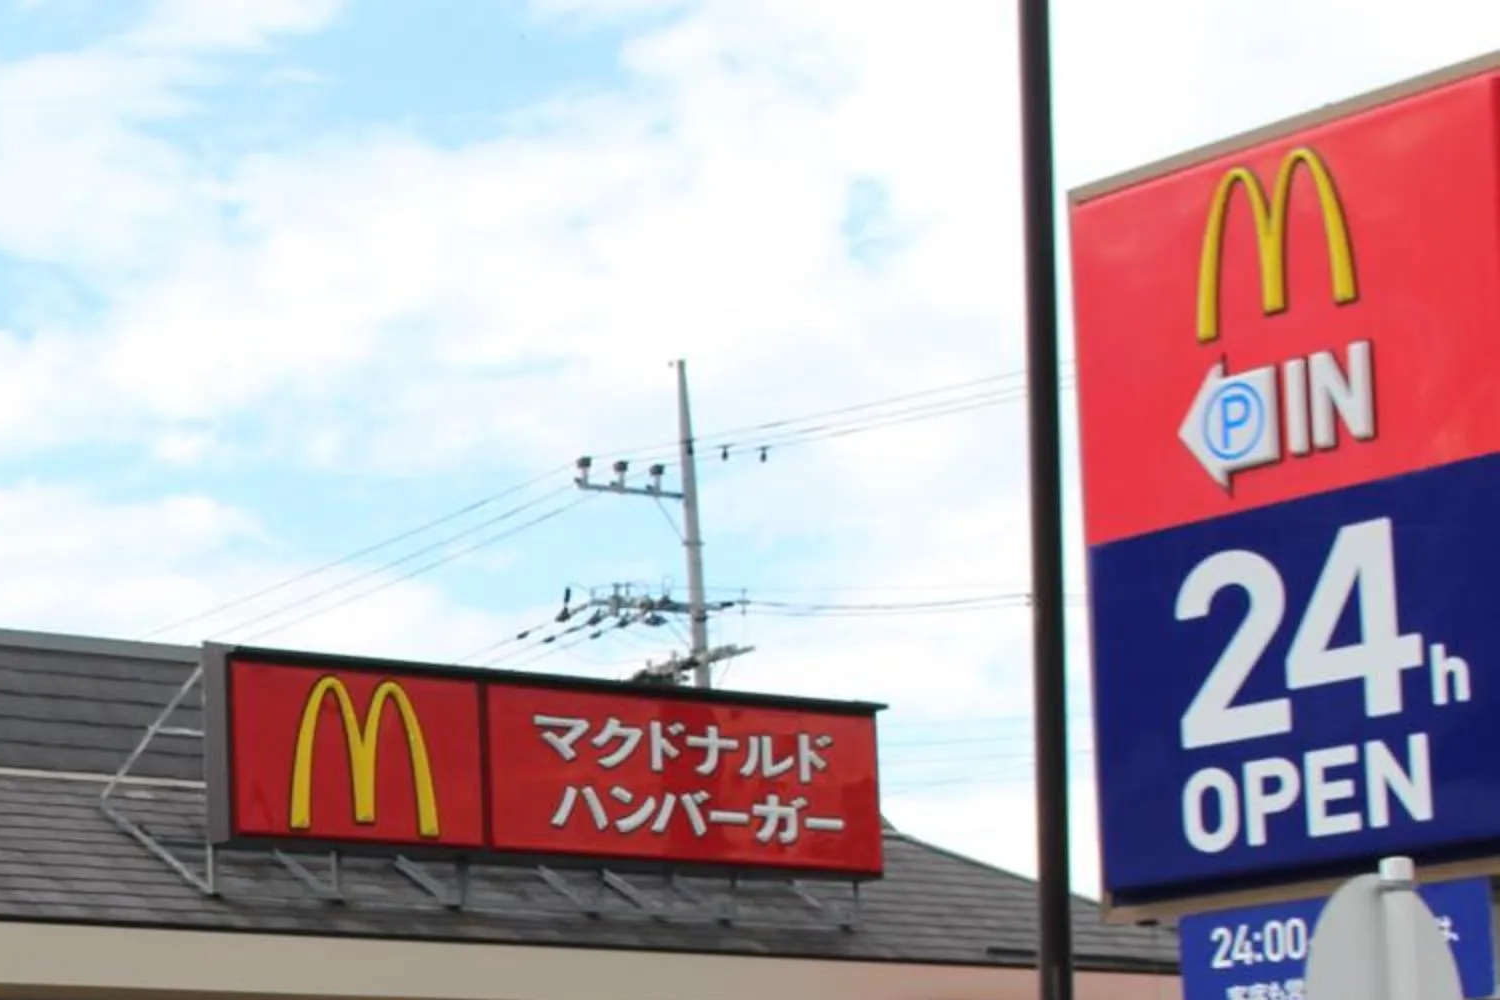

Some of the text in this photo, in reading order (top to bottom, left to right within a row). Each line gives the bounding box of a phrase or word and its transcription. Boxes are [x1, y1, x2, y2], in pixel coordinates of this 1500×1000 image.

[1283, 340, 1376, 456] IN
[533, 714, 833, 783] マクドナルド
[1181, 733, 1433, 853] OPEN
[550, 783, 845, 844] ハンバーガー
